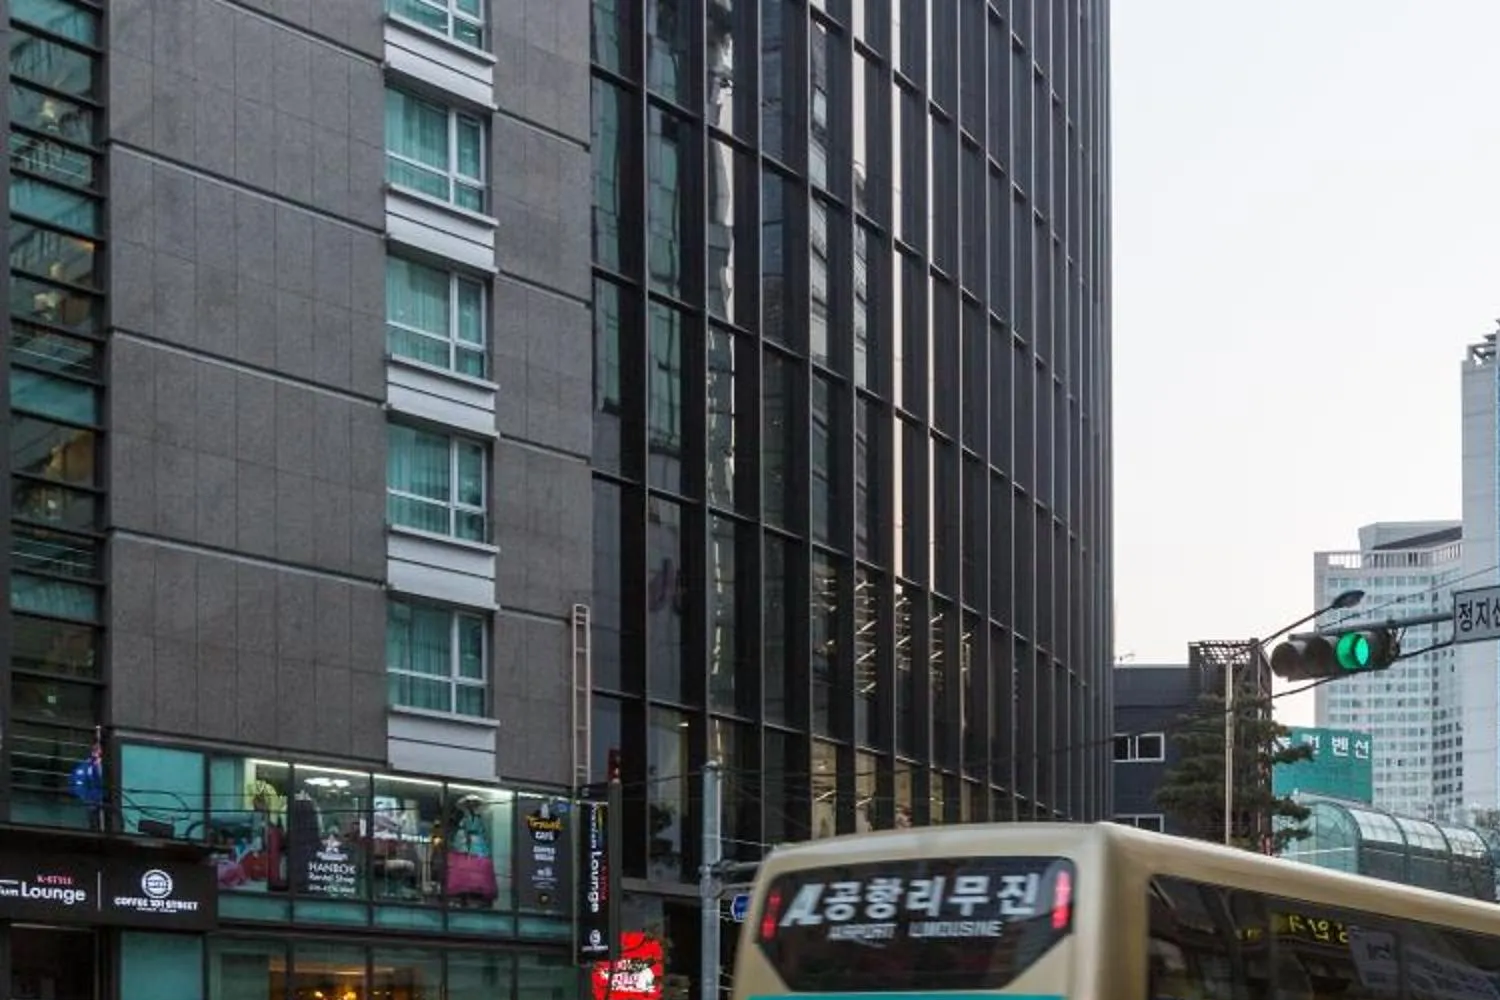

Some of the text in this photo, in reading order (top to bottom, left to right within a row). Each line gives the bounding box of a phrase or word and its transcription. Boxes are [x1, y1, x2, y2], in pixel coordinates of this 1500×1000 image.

[308, 862, 357, 875] HANBOK
[21, 881, 87, 905] Lounge
[587, 851, 603, 913] Lounge
[823, 871, 1041, 921] 공항리무진
[908, 920, 1004, 938] LIMOUSINE
